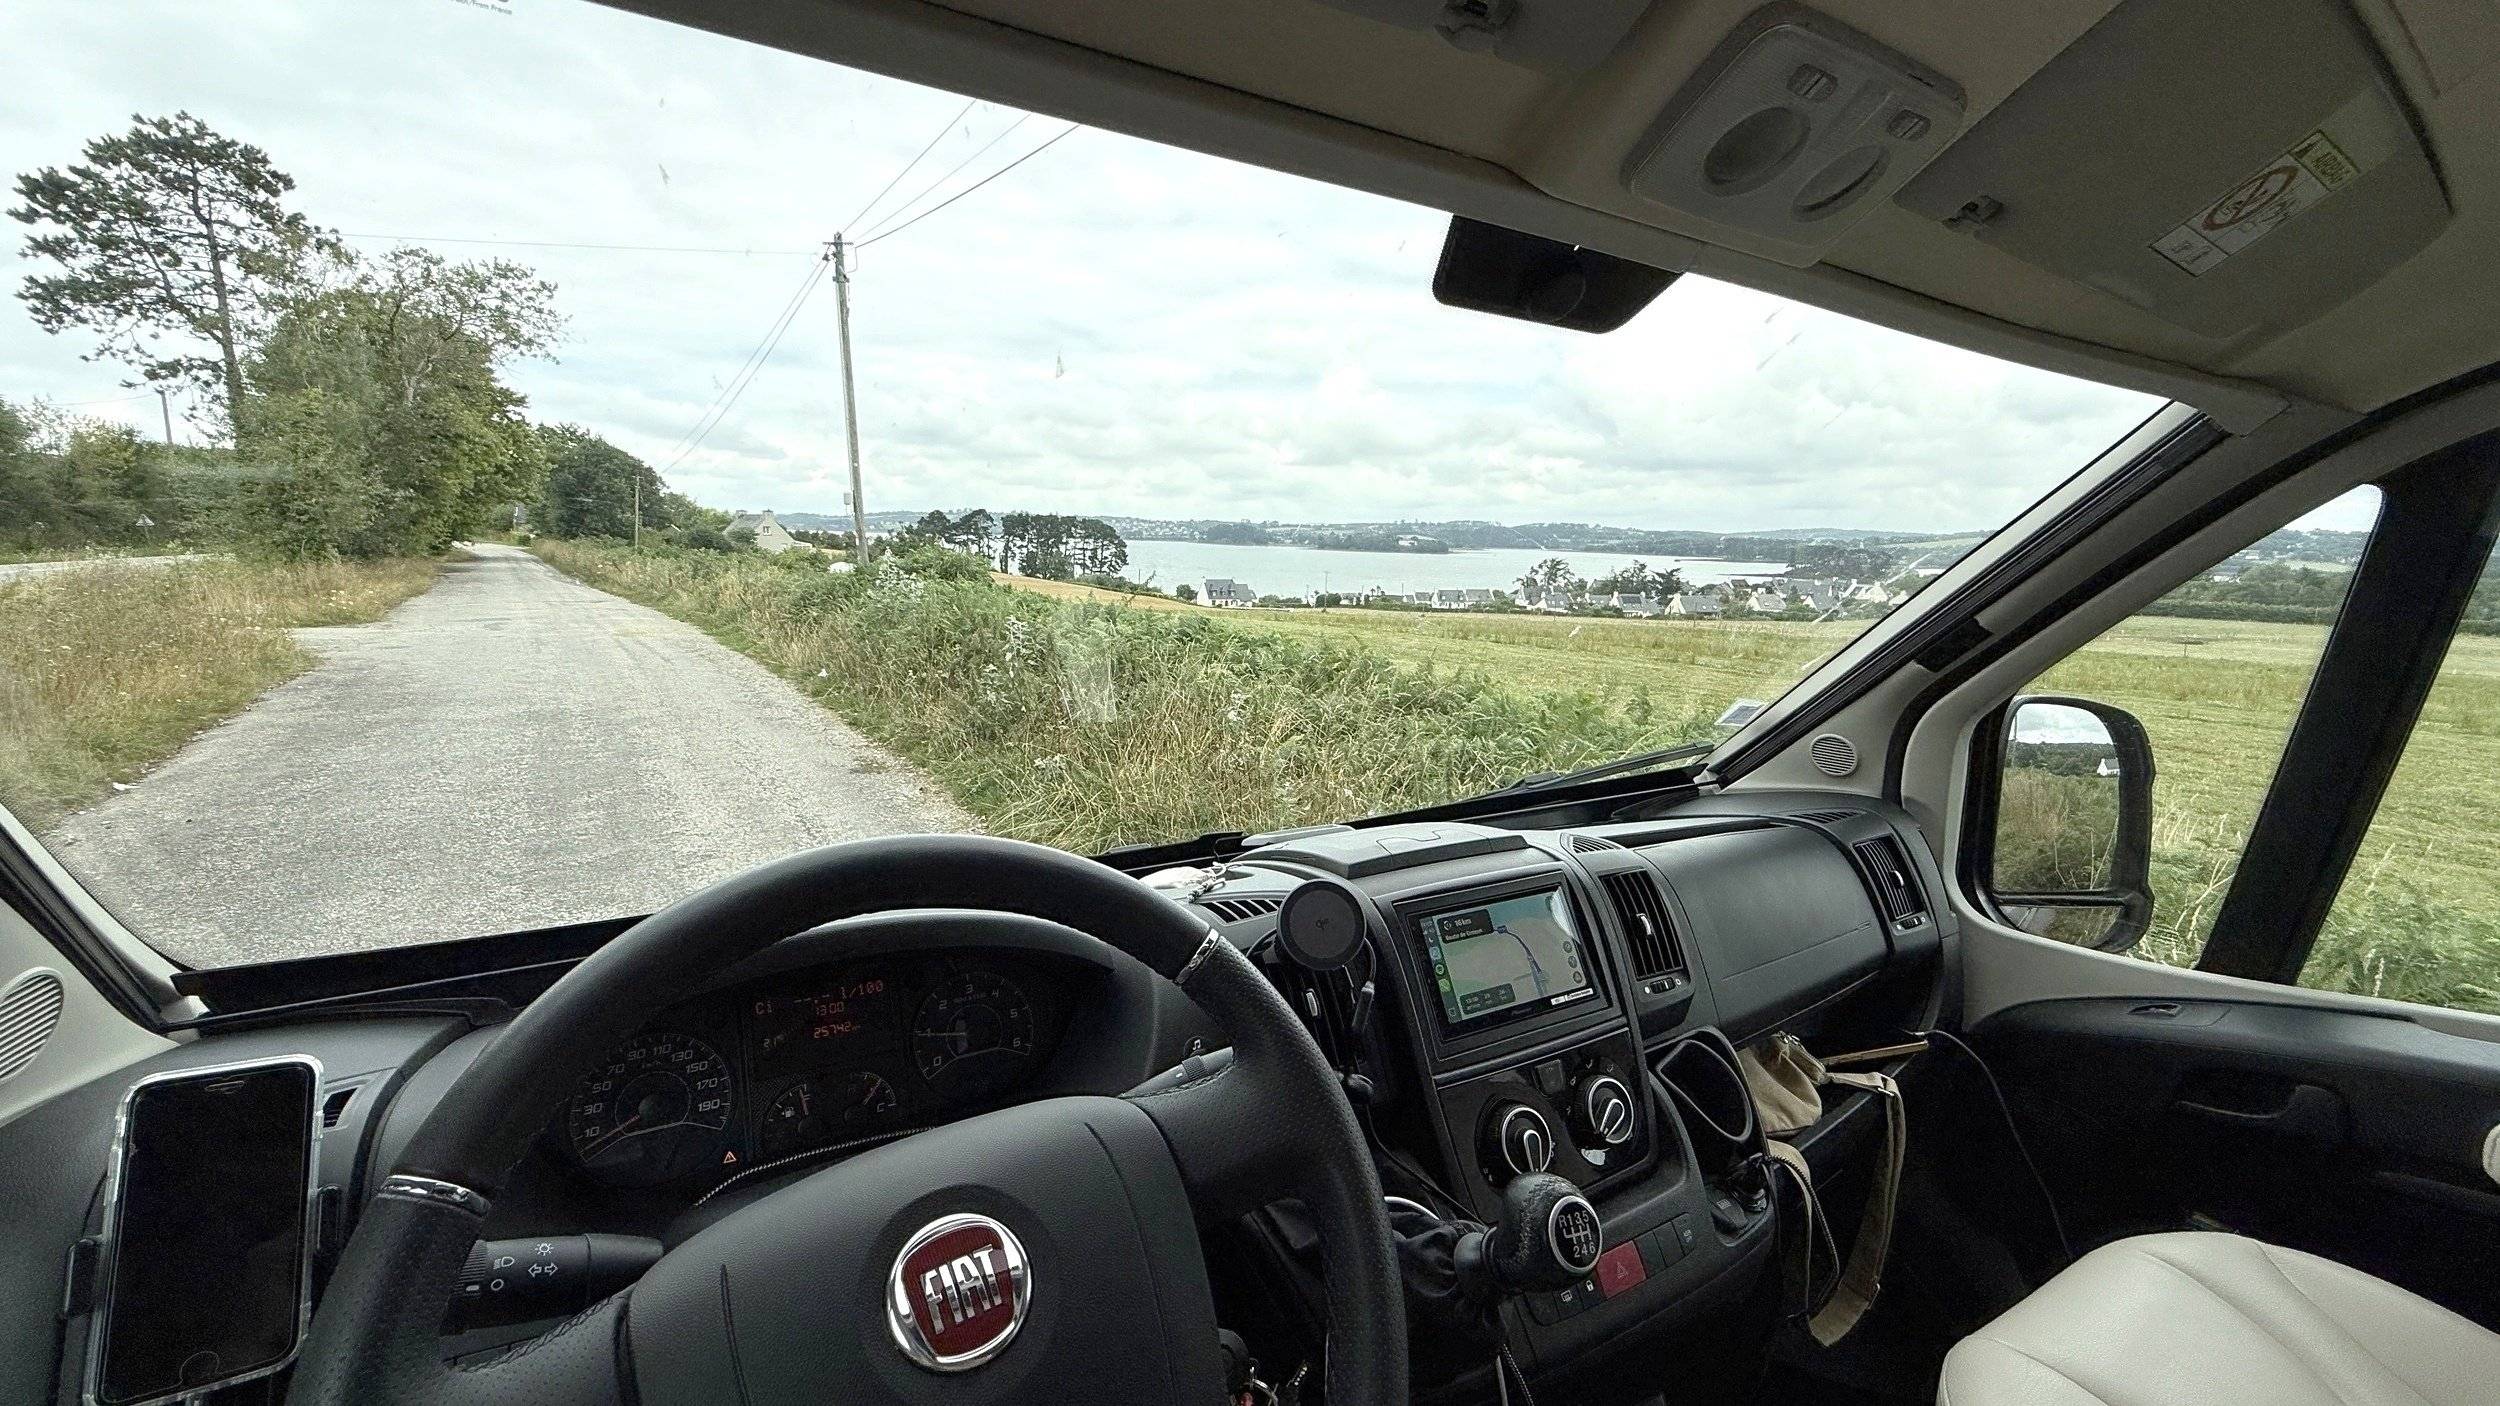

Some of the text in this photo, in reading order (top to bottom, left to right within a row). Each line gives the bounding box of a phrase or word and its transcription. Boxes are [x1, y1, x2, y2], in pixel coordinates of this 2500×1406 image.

[671, 1050, 693, 1063] 130
[685, 1060, 708, 1074] 150
[696, 1077, 718, 1090] 170
[584, 1103, 603, 1116] 30
[697, 1098, 720, 1112] 190
[584, 1126, 600, 1138] 10
[920, 1243, 1002, 1325] FIAT
